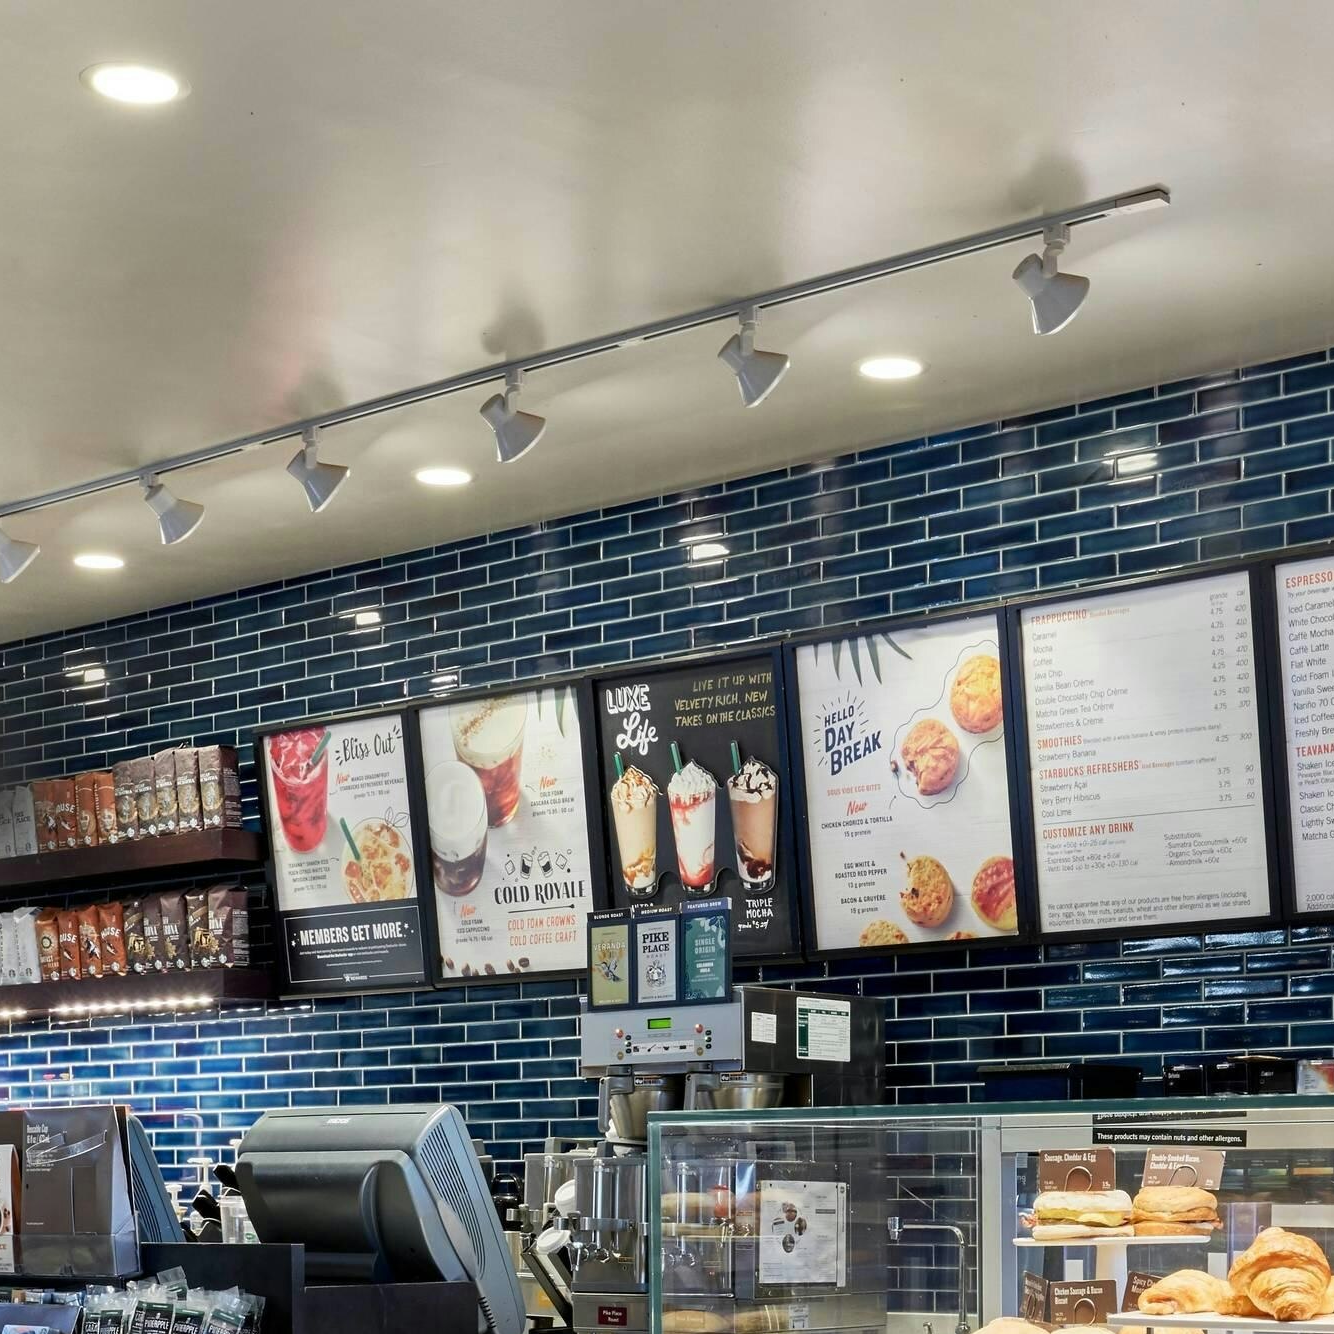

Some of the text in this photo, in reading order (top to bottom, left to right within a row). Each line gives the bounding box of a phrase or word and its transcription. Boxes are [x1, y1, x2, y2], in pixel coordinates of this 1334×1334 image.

[1285, 570, 1333, 589] ESPRESSO
[1288, 604, 1303, 614] Iced
[1305, 599, 1334, 612] Caramel
[1030, 609, 1087, 625] FRAPPUCCINO
[1288, 617, 1309, 628] White
[693, 672, 772, 692] LIVE IT UP WITH
[605, 683, 651, 714] LUXE
[674, 696, 713, 711] VELVETY
[745, 690, 768, 703] NEW
[675, 705, 776, 727] TAKES ON THE CLASSICS
[824, 705, 855, 726] HELLO
[616, 712, 659, 756] Life
[825, 721, 855, 753] DAY
[342, 733, 396, 762] Bliss Out
[1037, 735, 1083, 750] SMOOTHIES
[830, 730, 882, 776] BREAK
[1039, 764, 1084, 781] STARBUCKS
[821, 821, 842, 830] CHICKEN
[842, 819, 864, 828] CHORIZO
[869, 816, 893, 824] TORTILLA
[1042, 822, 1135, 840] CUSTOMIZE ANY DRINK
[494, 880, 586, 905] COLD ROYALE
[746, 898, 773, 908] TRIPLE
[746, 909, 774, 919] MOCHA
[508, 915, 576, 930] COLD FOAM CROWNS
[299, 921, 401, 946] MEMBERS GET MORE
[510, 931, 576, 946] COLD COFFEE CRAFT
[642, 932, 669, 944] PIKE
[642, 943, 670, 954] PLACE
[1097, 1132, 1113, 1140] These
[1114, 1133, 1138, 1141] products
[1215, 1135, 1242, 1143] allergens.
[1064, 1152, 1081, 1162] Cheddar
[1082, 1153, 1087, 1161] &
[1088, 1152, 1096, 1163] Egg
[144, 1319, 170, 1330] PINEAPPLE
